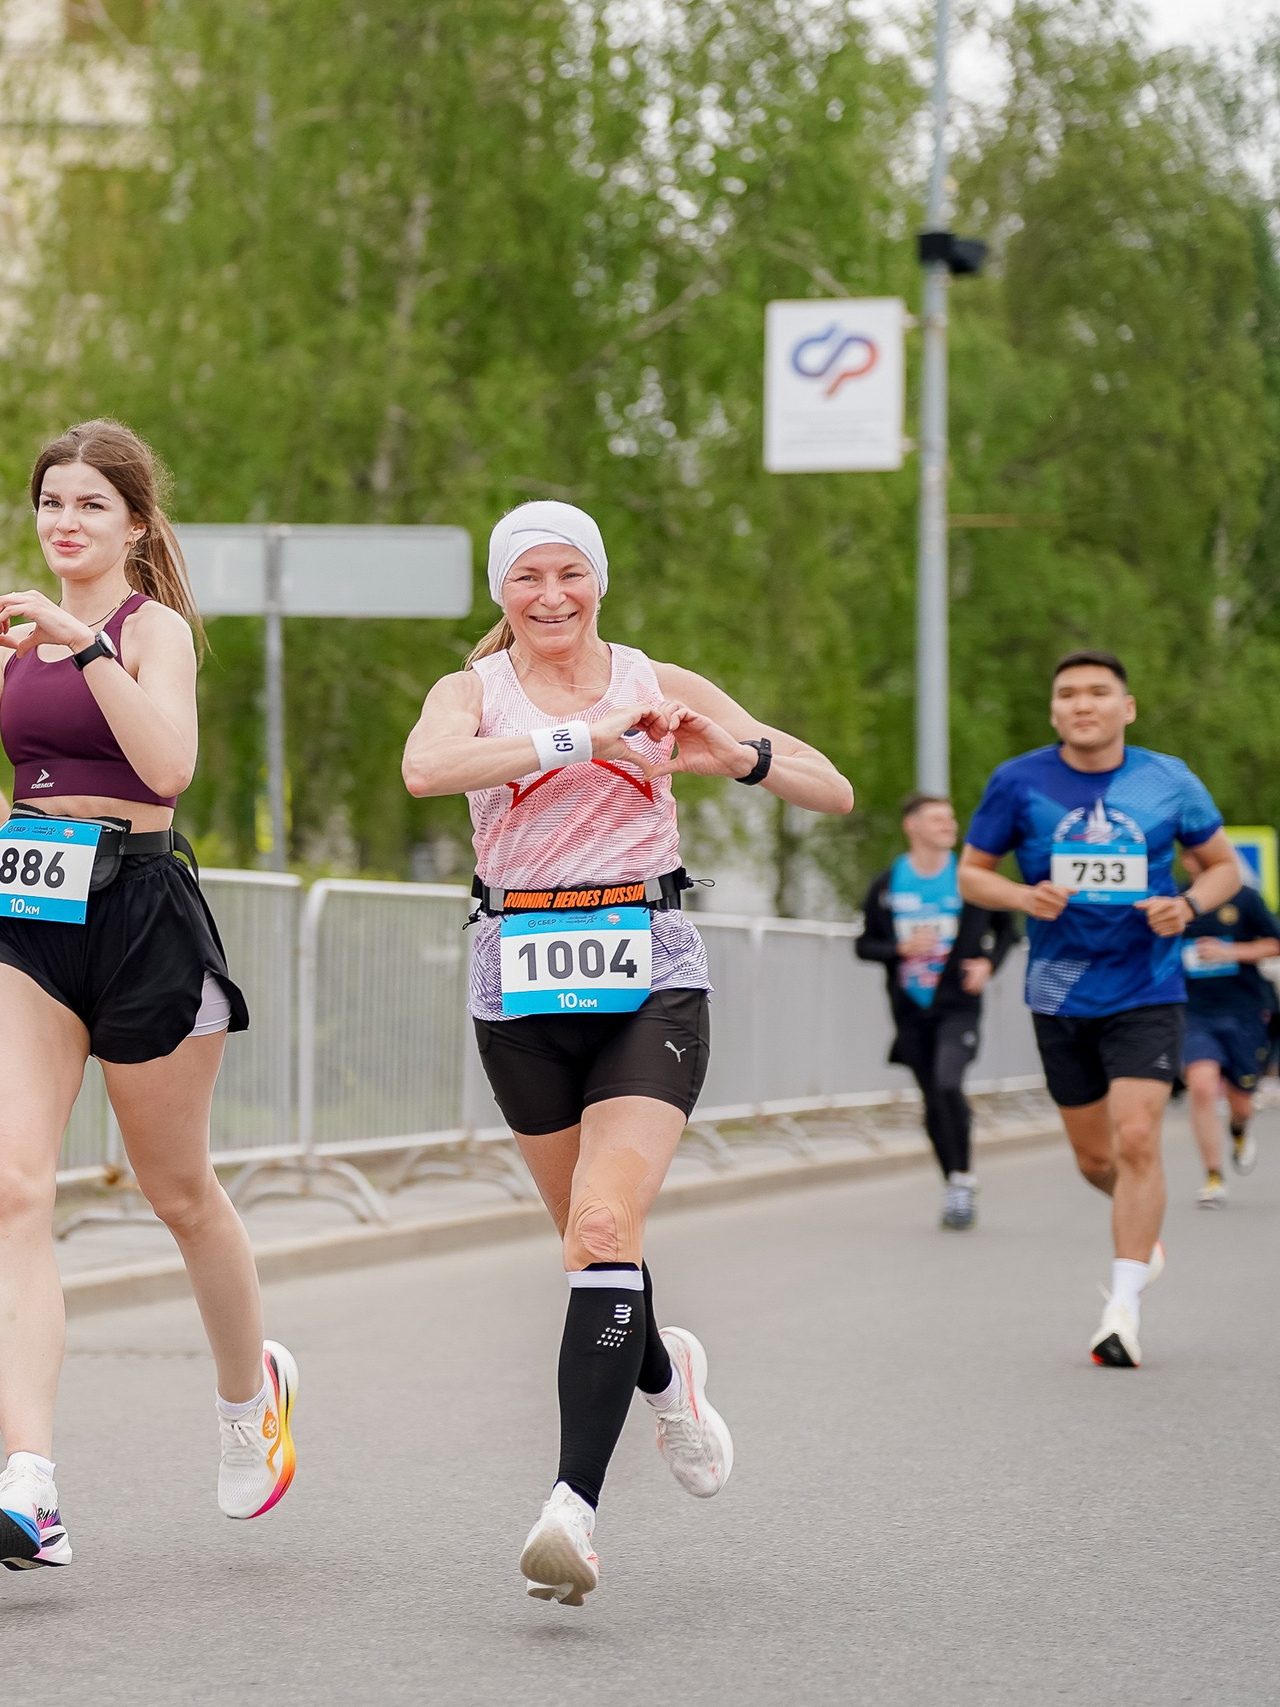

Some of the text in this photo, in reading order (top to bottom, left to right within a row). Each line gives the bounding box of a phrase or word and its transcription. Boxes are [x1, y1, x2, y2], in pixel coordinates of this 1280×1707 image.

[30, 781, 55, 790] DEMIX
[1071, 861, 1126, 884] 733
[503, 883, 645, 909] RUNNING HEROES RUSSIA
[518, 938, 638, 982] 1004
